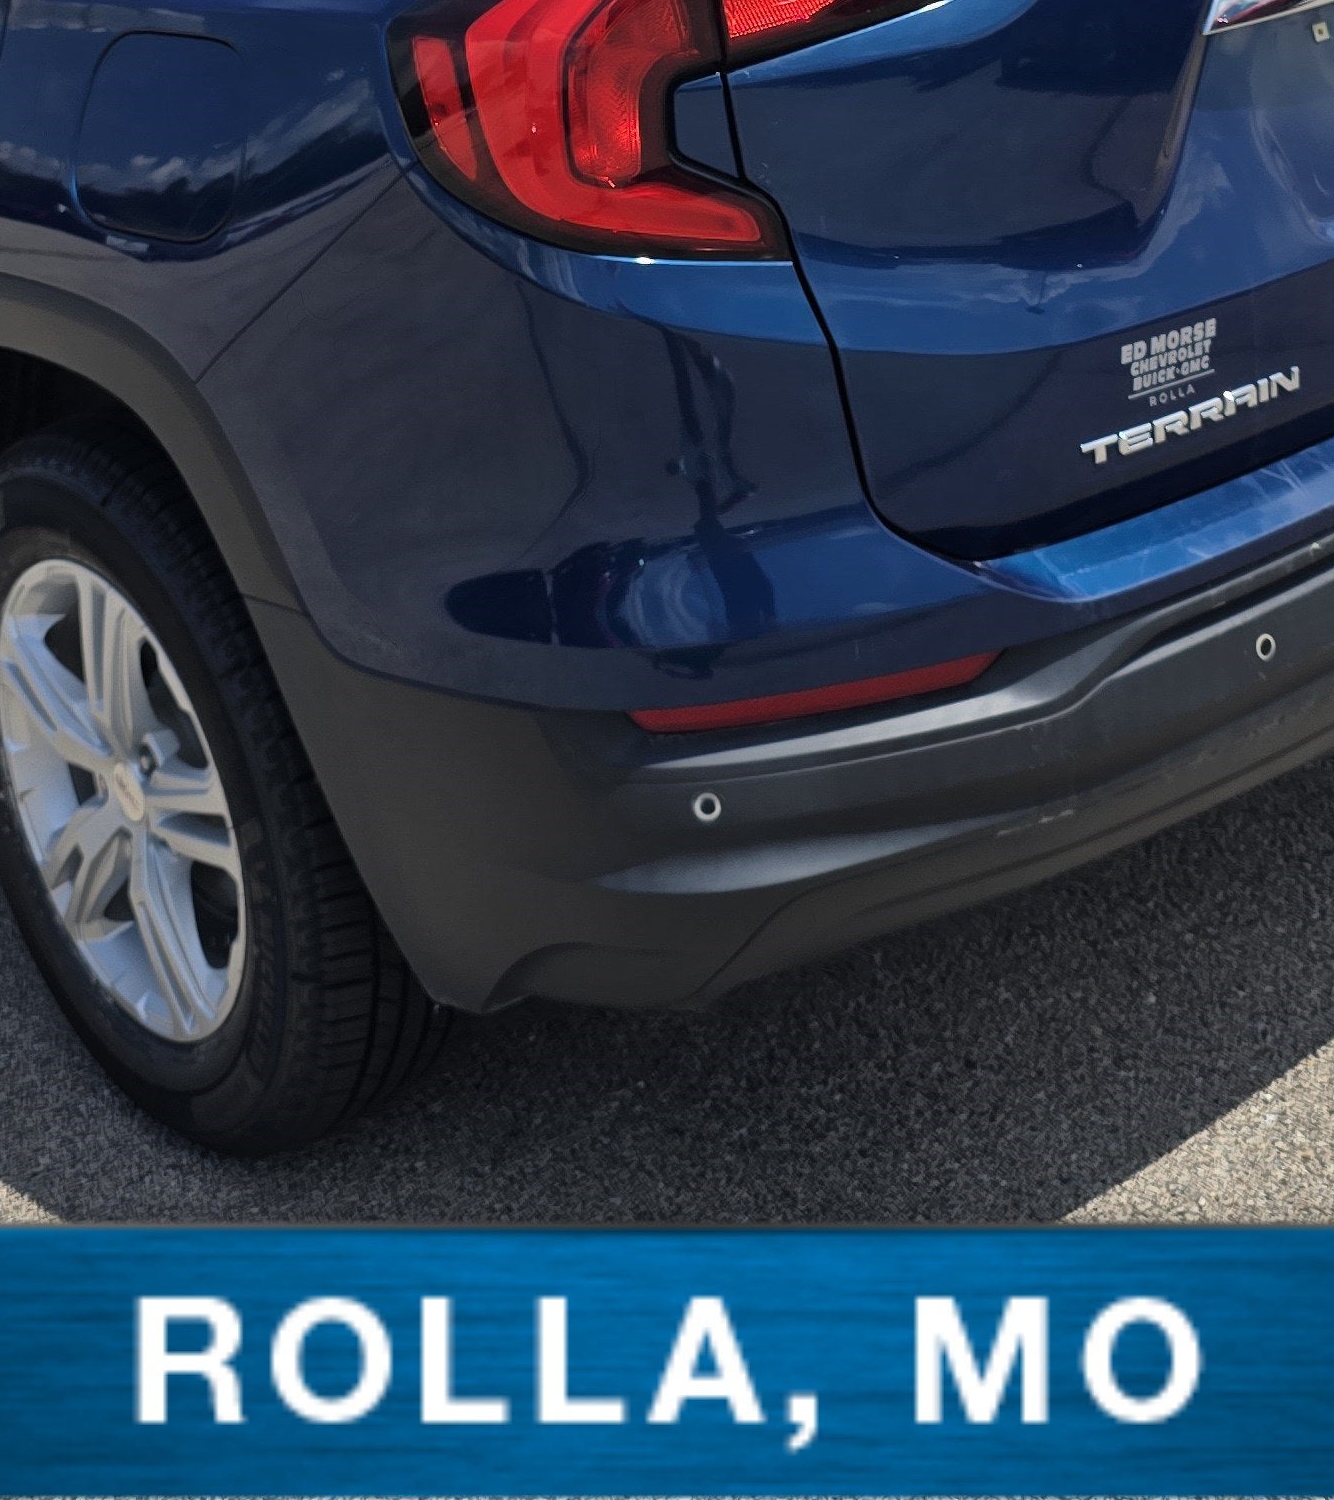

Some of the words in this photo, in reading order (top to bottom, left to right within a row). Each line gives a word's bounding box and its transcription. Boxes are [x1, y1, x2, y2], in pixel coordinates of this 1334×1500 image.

[1120, 340, 1147, 365] ED
[1149, 317, 1217, 354] MORSE
[1130, 338, 1213, 377] CHEVROLET
[1080, 365, 1300, 465] TERRAIN
[1149, 382, 1196, 408] ROLLA
